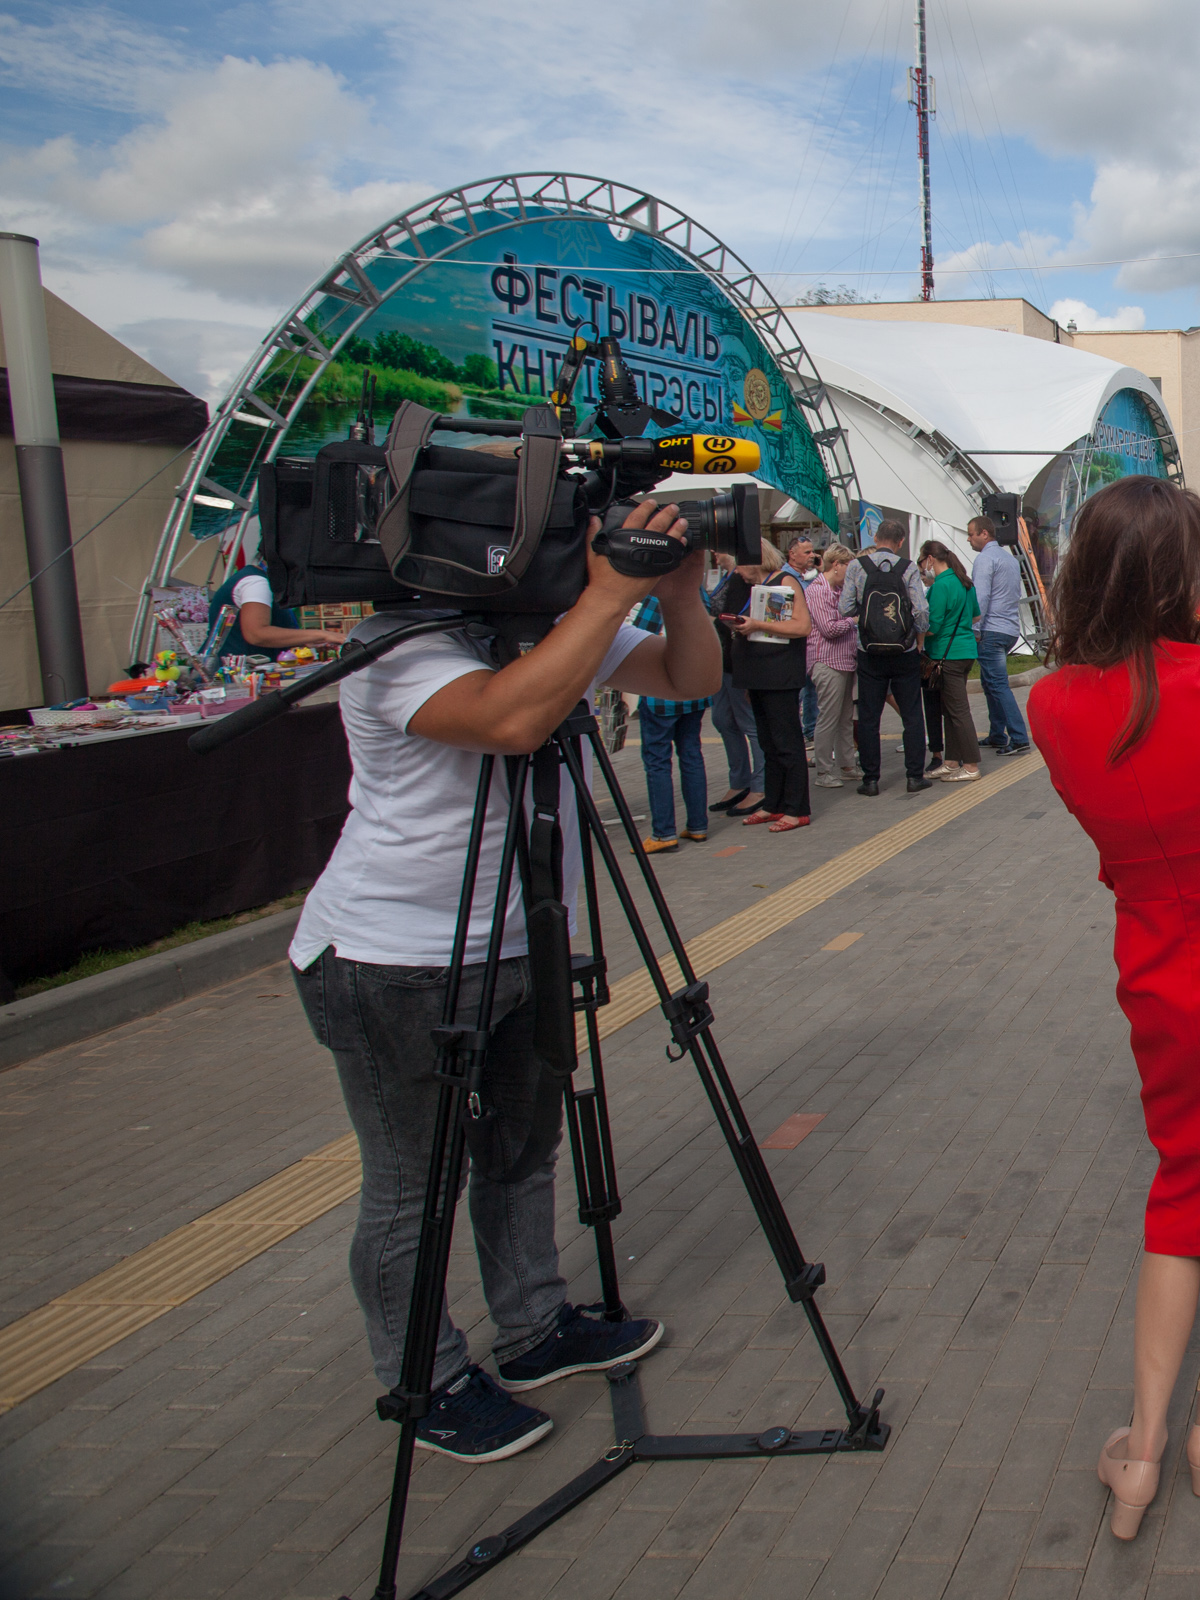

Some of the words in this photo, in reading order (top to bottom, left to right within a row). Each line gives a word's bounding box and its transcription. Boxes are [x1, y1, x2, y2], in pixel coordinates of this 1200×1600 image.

[490, 252, 722, 362] ФЕСТЫВАЛЬ
[493, 339, 598, 405] КНІІ
[659, 437, 691, 448] ОНТ
[630, 536, 669, 546] FUJINON
